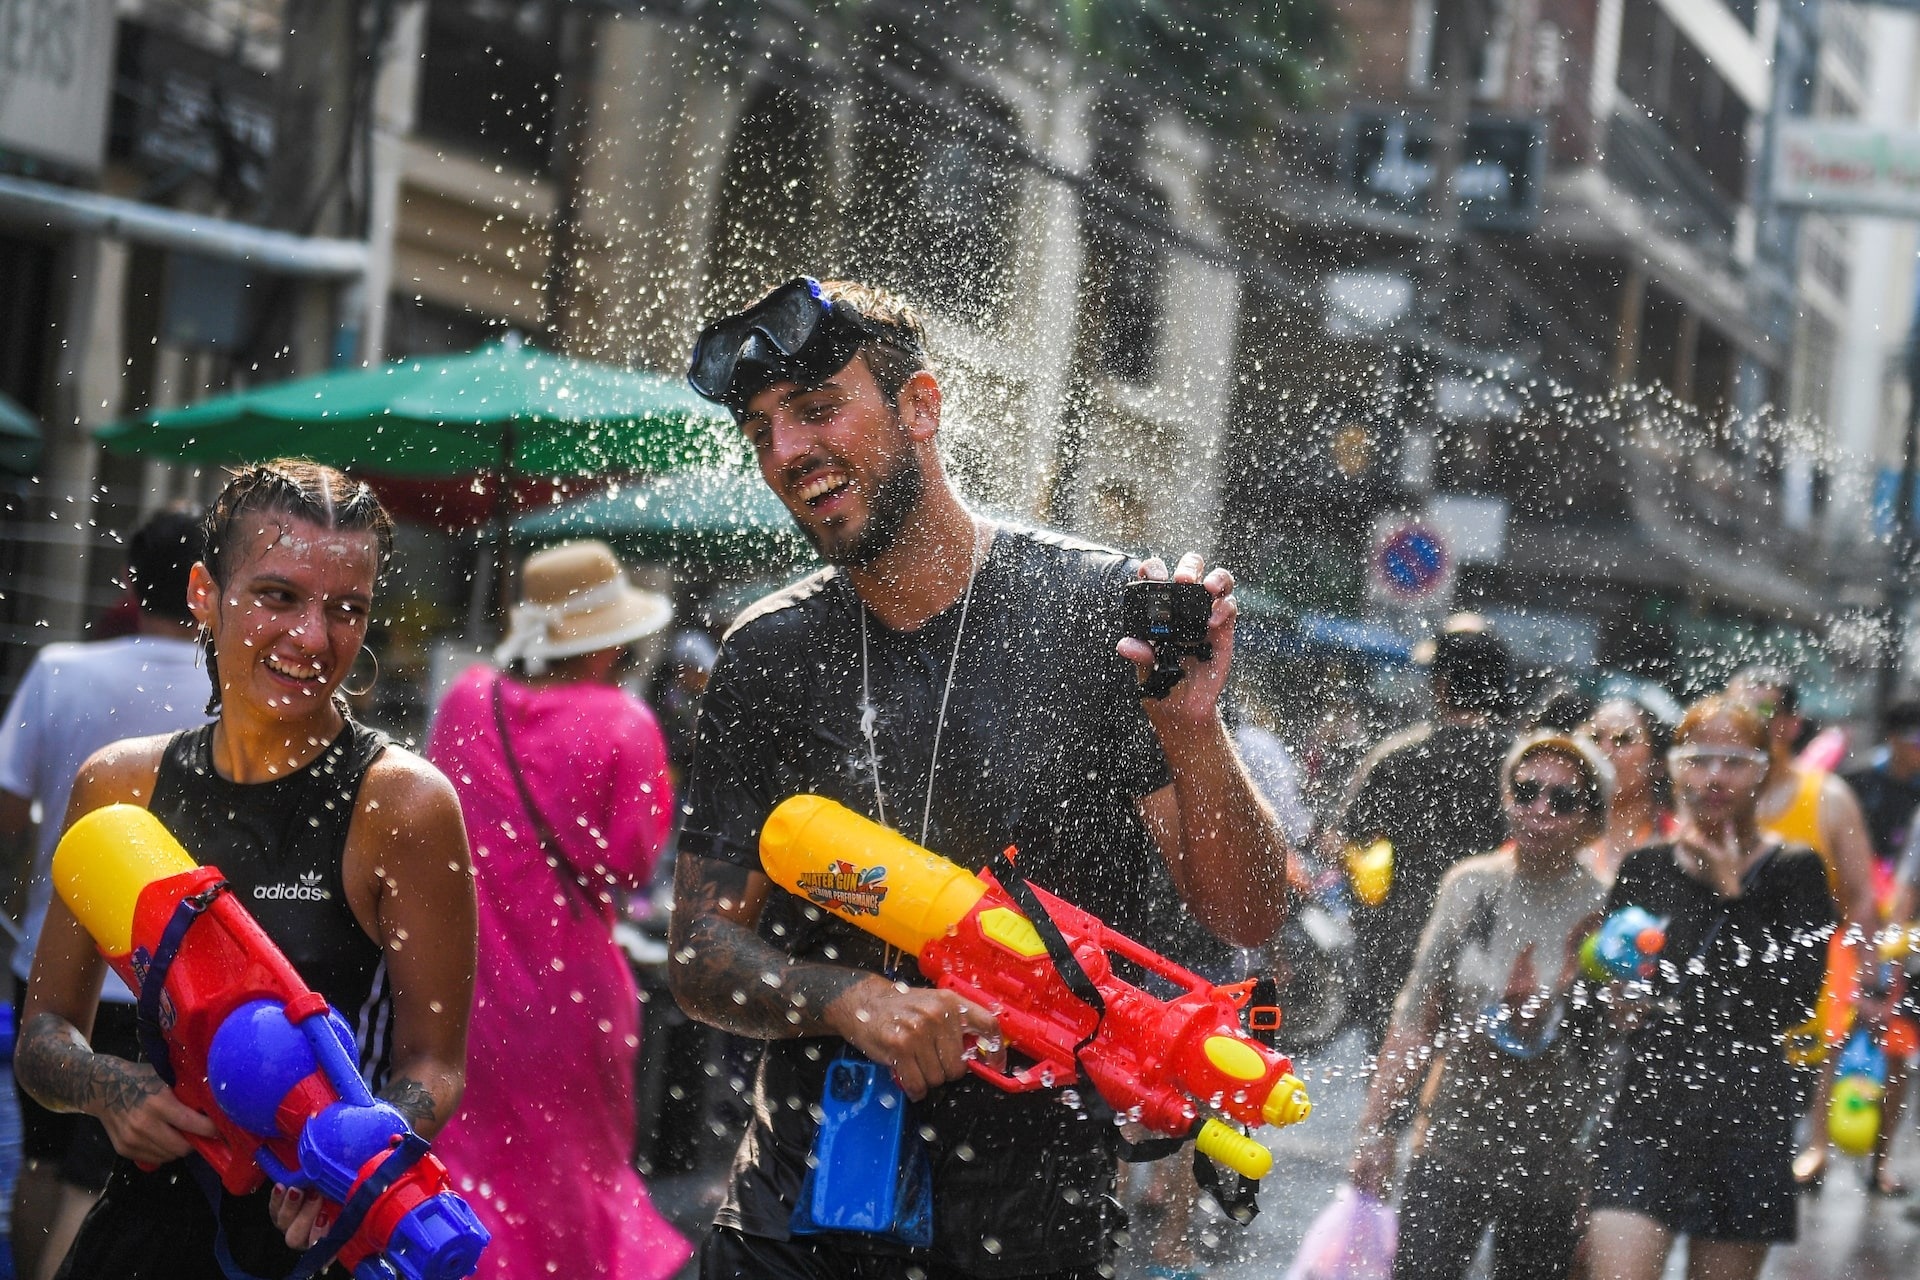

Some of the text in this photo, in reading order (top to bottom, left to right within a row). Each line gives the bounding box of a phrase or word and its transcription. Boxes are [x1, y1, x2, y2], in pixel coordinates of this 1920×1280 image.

[801, 872, 859, 891] WATER GUN
[253, 883, 322, 901] adidas
[803, 884, 879, 909] PERIOR PERFORMANCE
